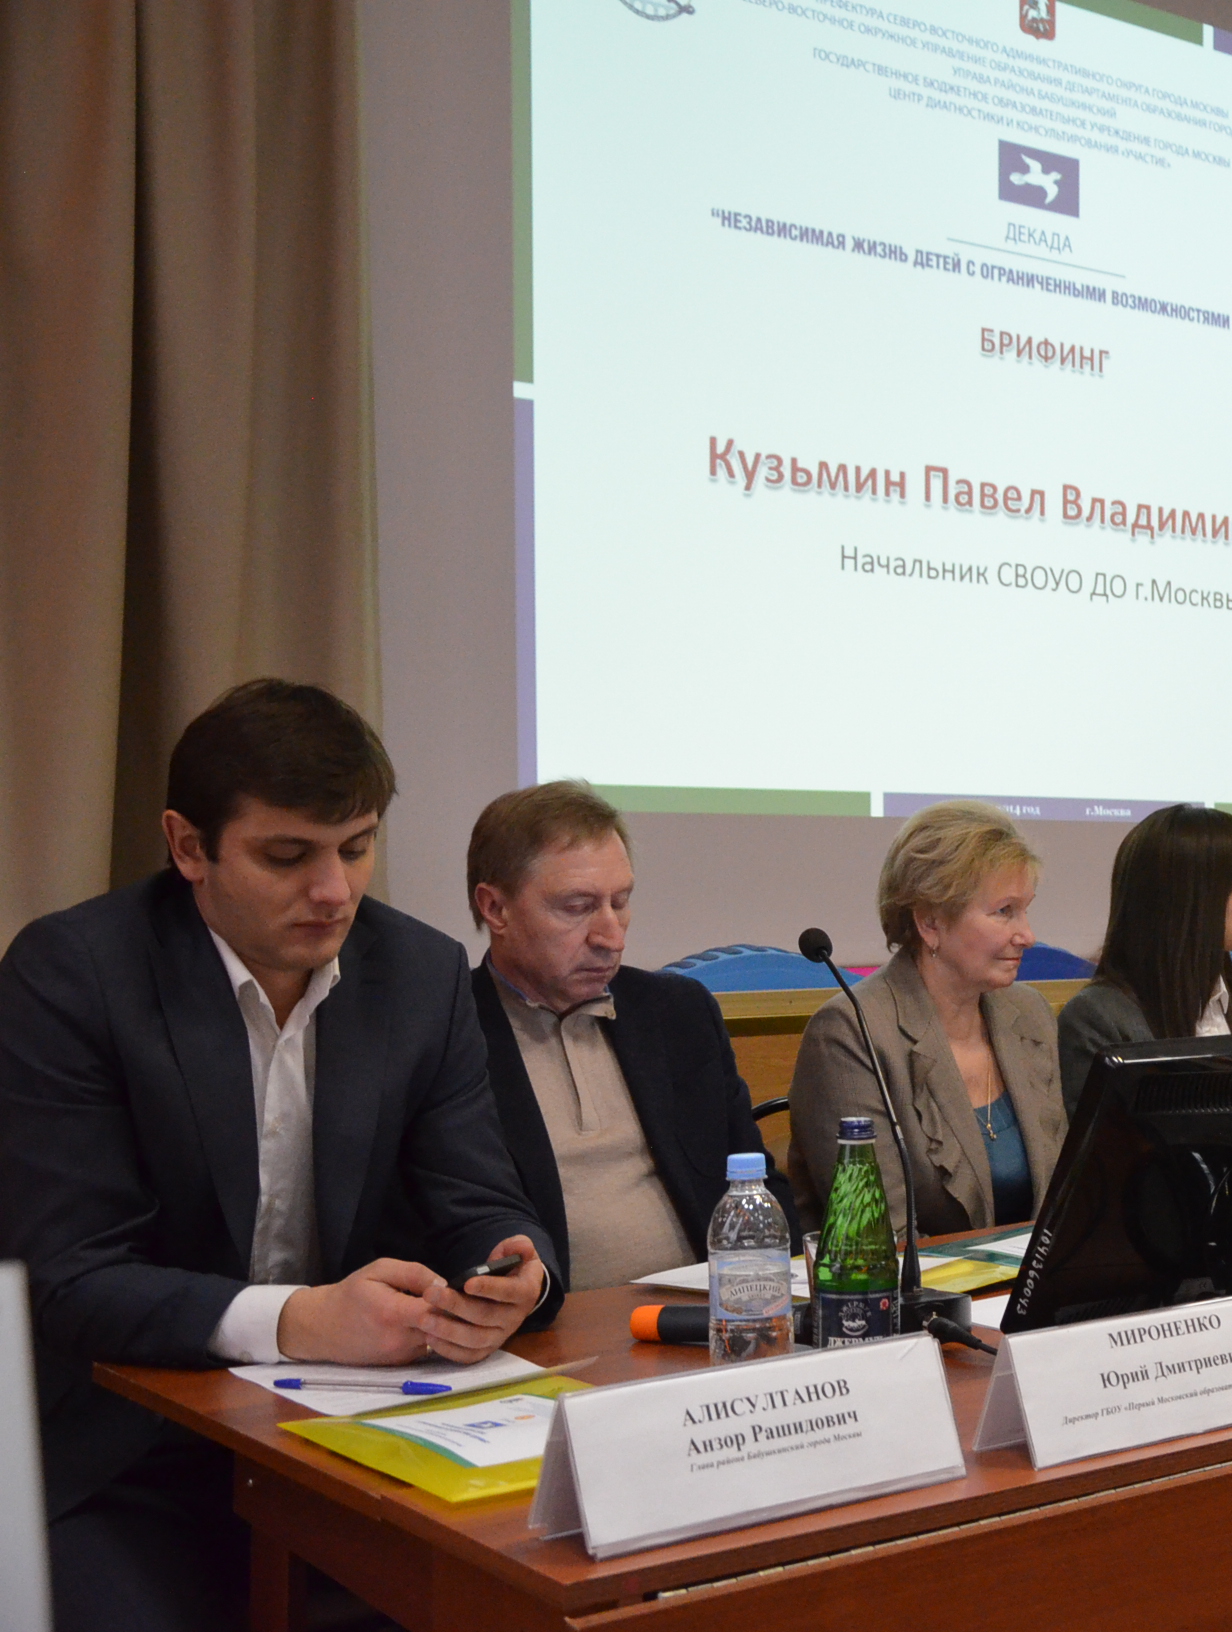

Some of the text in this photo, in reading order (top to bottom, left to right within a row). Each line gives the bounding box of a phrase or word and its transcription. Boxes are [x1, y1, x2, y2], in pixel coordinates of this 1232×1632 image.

[857, 22, 919, 50] ОКРУЖНОЕ
[920, 39, 987, 68] УПРАВЛЕНИЕ
[989, 59, 1064, 88] ОБРАЗОВАНИЯ
[1064, 80, 1140, 110] ДЕПАРТАМЕНТА
[1141, 101, 1208, 129] ОБРАЗОВАНИЯ
[951, 66, 1117, 119] УПРАВА РАЙОНА БАБУШКИНСКИЙ
[1115, 77, 1151, 97] ОКРУГА
[1152, 88, 1190, 109] ГОРОДА
[1190, 98, 1230, 119] МОСКВЫ
[812, 47, 1231, 169] ГОСУДАРСТВЕННОЕ БЮДЖЕТНОЕ ОБРАЗОВАТЕЛЬНОЕ УЧРЕЖДЕНИЕ ГОРОДА МОСКВЫ
[888, 86, 924, 105] ЦЕНТР
[925, 95, 1005, 125] ДИАГНОСТИКИ
[1005, 115, 1014, 128] И
[1016, 120, 1119, 156] КОНСУЛЬТИРОВАНИЯ
[1004, 221, 1074, 255] ДЕКАДА
[850, 235, 909, 265] ЖИЗНЬ
[912, 248, 962, 275] ДЕТЕЙ
[965, 259, 976, 278] С
[979, 262, 1107, 305] ОГРАНИЧЕННЫМИ
[1110, 289, 1231, 331] ВОЗМОЖНОСТЯМИ
[980, 326, 1111, 376] БРИФИНГ
[708, 435, 907, 502] Кузьмин
[923, 464, 1047, 518] Павел
[840, 544, 989, 586] Начальник
[996, 561, 1084, 595] СВОУО
[1089, 572, 1128, 604] ДО
[1016, 1227, 1053, 1316] 1041360043
[1107, 1313, 1222, 1349] МИРОНЕНКО
[1099, 1364, 1150, 1390] Юрий
[682, 1378, 851, 1428] АЛИСУЛТАНОВ
[1100, 1405, 1123, 1417] ГБОУ
[687, 1410, 860, 1457] Анзор Рашидович
